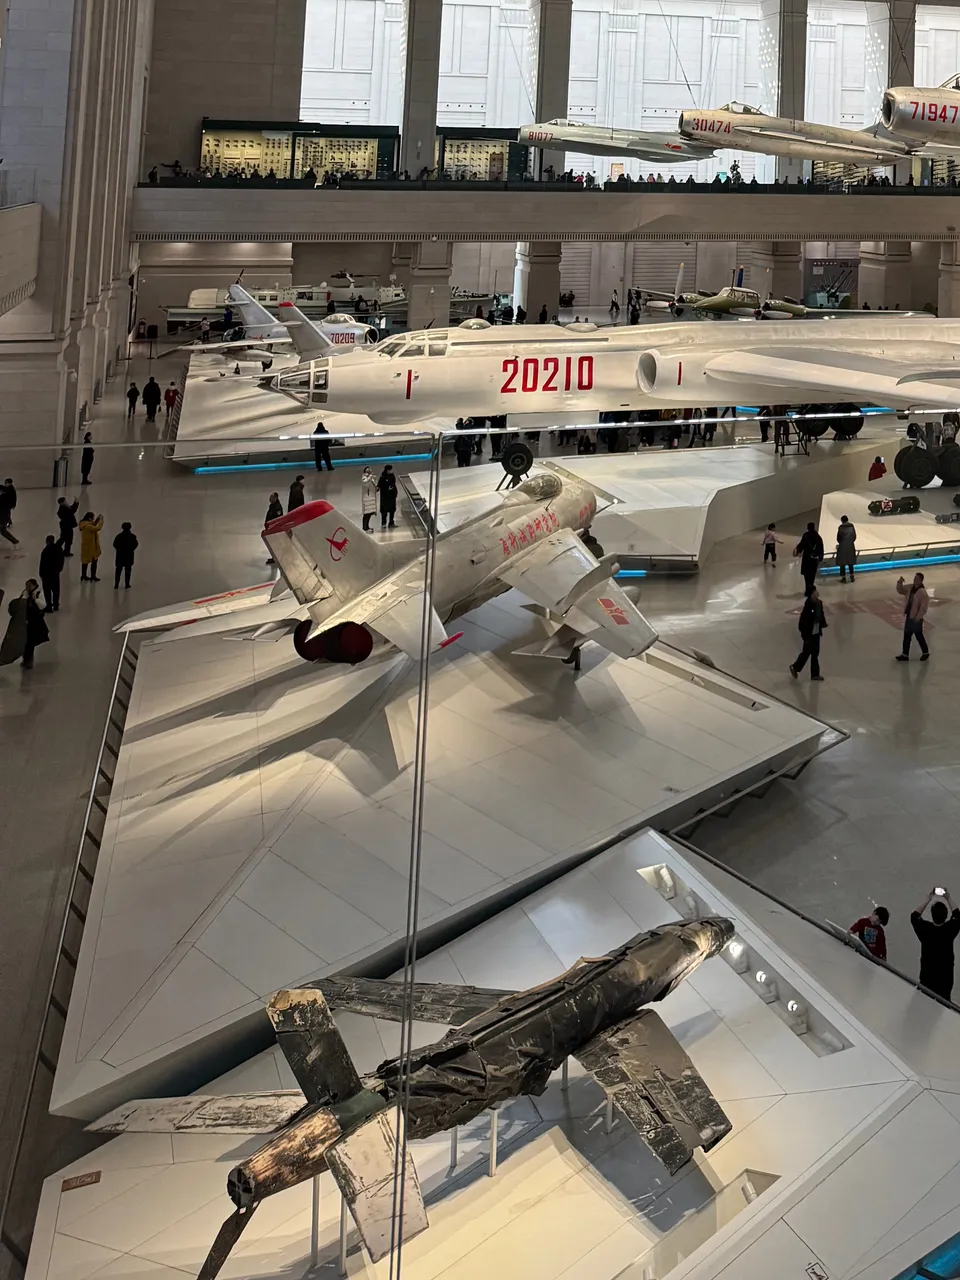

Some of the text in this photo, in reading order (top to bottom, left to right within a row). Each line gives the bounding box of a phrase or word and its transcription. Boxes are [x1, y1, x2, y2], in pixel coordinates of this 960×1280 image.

[910, 101, 958, 123] 71947
[691, 118, 731, 135] 30474
[528, 131, 554, 142] 81077
[330, 332, 355, 344] 70209
[501, 355, 594, 394] 20210
